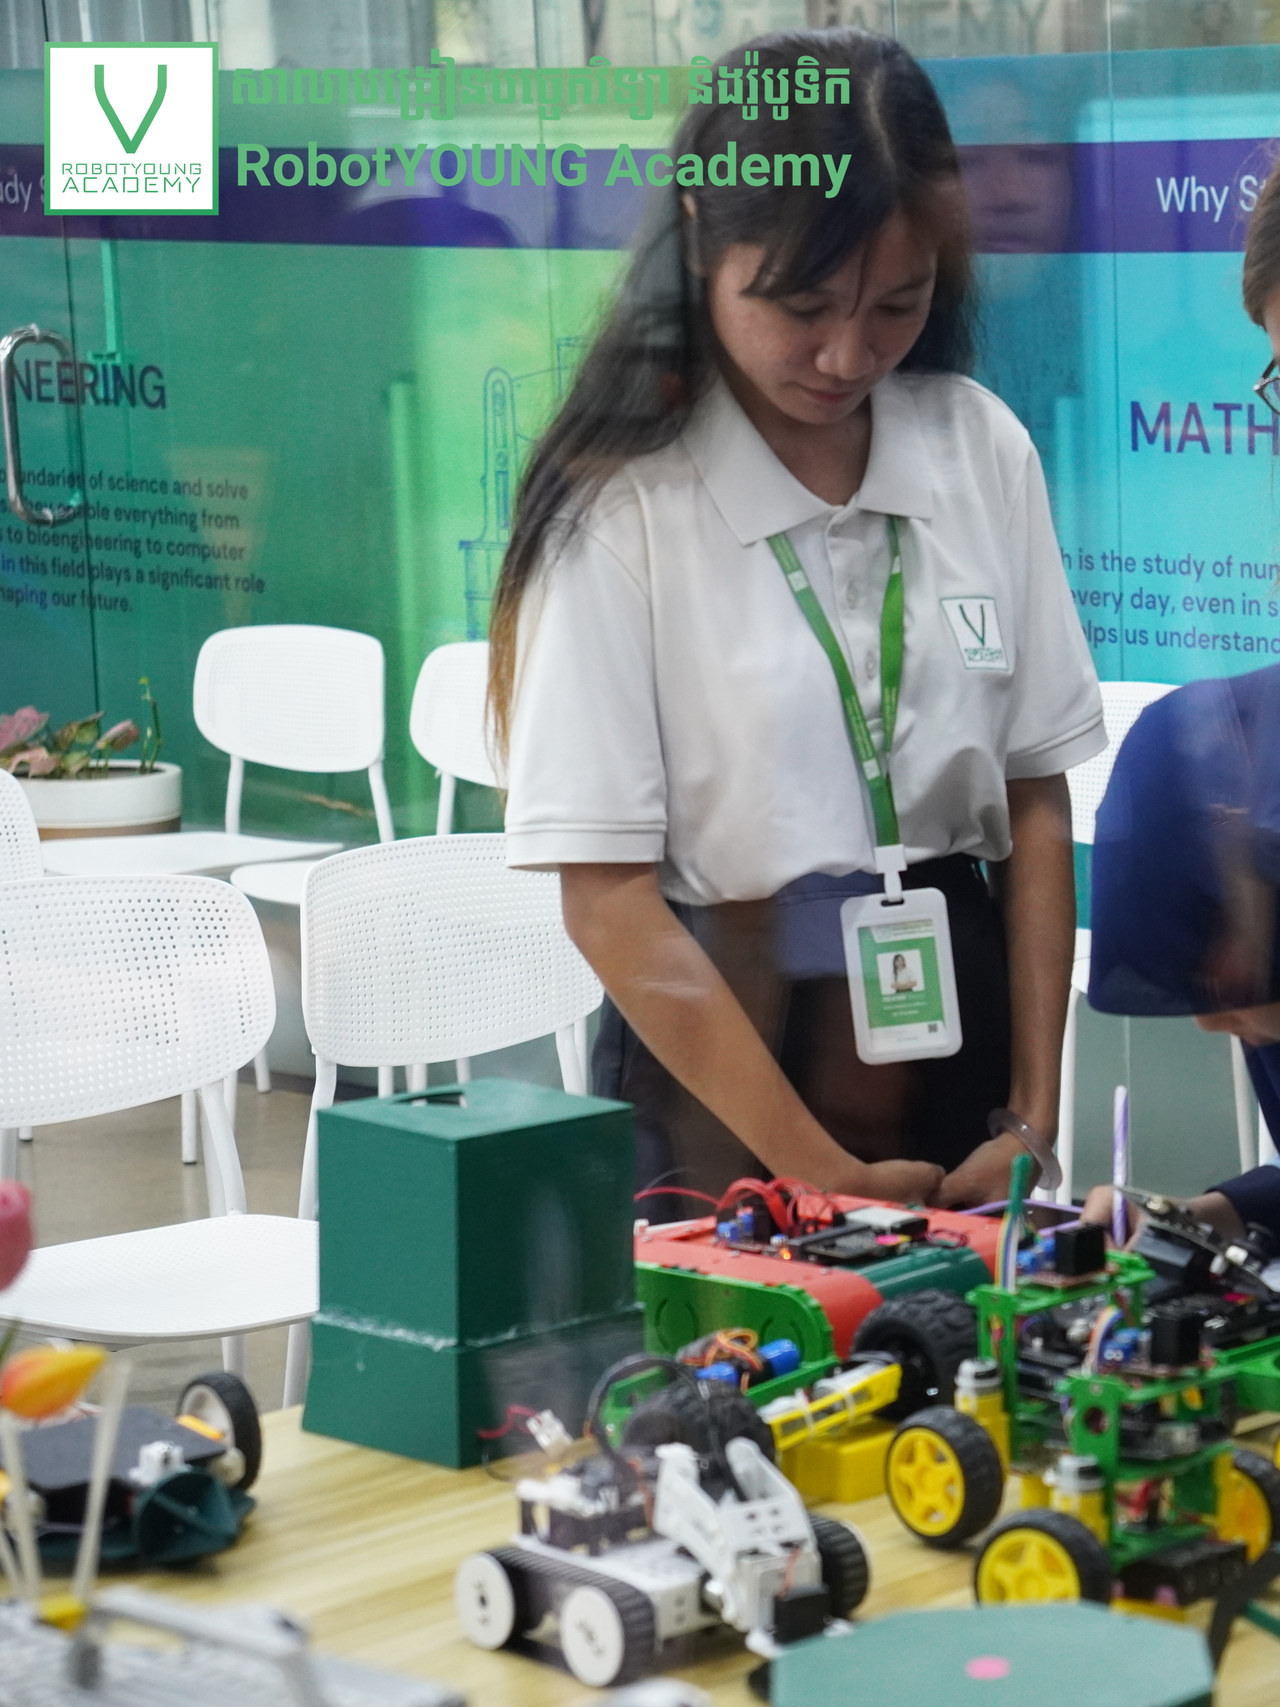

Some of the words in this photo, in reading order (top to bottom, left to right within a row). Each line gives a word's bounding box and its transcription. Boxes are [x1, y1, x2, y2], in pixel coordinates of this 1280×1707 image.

[1156, 175, 1230, 222] Why
[1240, 174, 1266, 212] S
[1130, 400, 1280, 456] MATH
[90, 471, 103, 488] of
[108, 473, 169, 495] science
[173, 478, 202, 496] and
[206, 478, 249, 500] solve
[114, 506, 198, 532] everything
[202, 510, 240, 529] from
[26, 528, 142, 558] bioengineering
[146, 539, 163, 555] to
[167, 542, 245, 563] computer
[20, 556, 48, 576] this
[52, 557, 88, 578] field
[91, 561, 132, 586] plays
[148, 568, 232, 592] significant
[235, 574, 267, 594] role
[1079, 549, 1095, 571] is
[1101, 550, 1137, 573] the
[1143, 553, 1206, 582] study
[1212, 555, 1233, 578] of
[52, 592, 77, 608] our
[1130, 587, 1176, 615] day,
[1182, 595, 1235, 615] even
[1242, 592, 1261, 616] in
[1125, 629, 1149, 646] us
